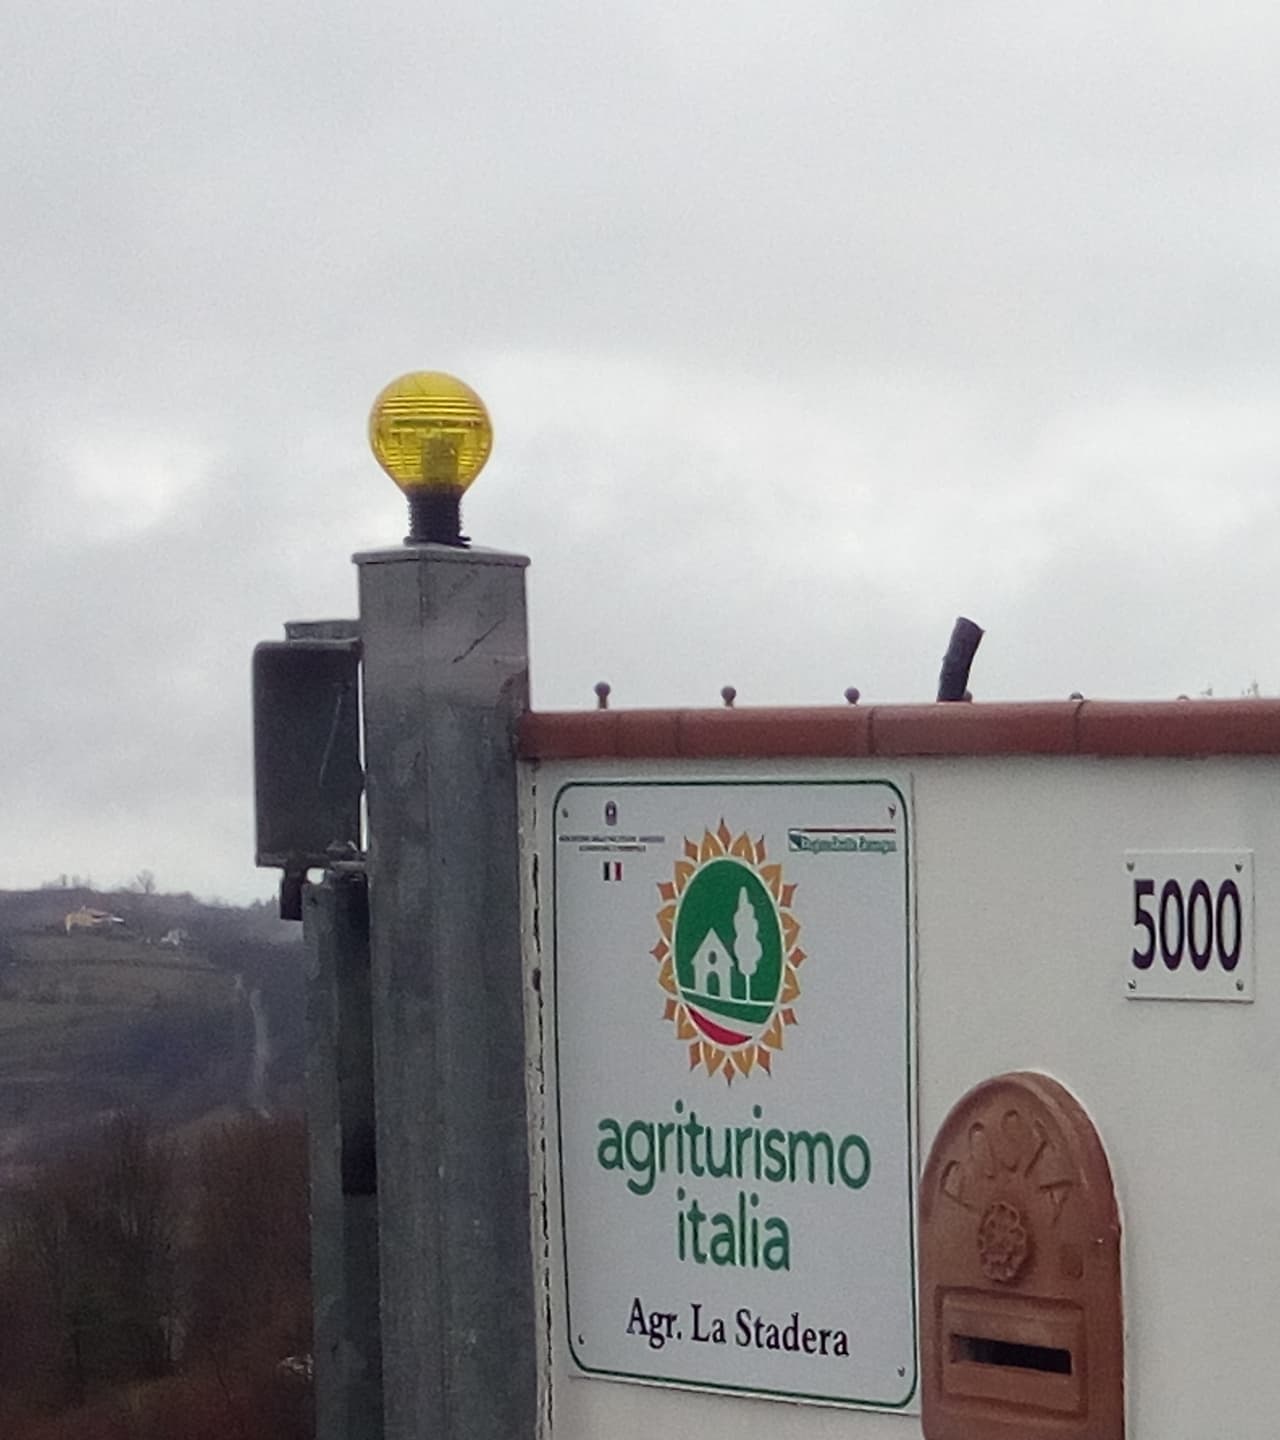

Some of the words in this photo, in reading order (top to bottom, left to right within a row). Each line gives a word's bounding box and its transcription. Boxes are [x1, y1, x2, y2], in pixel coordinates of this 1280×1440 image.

[1131, 878, 1242, 971] 5000
[598, 1099, 871, 1195] agriturismo
[677, 1187, 790, 1271] italia
[626, 1297, 682, 1350] Agr.
[691, 1303, 727, 1343] La
[736, 1308, 850, 1357] Stadera
